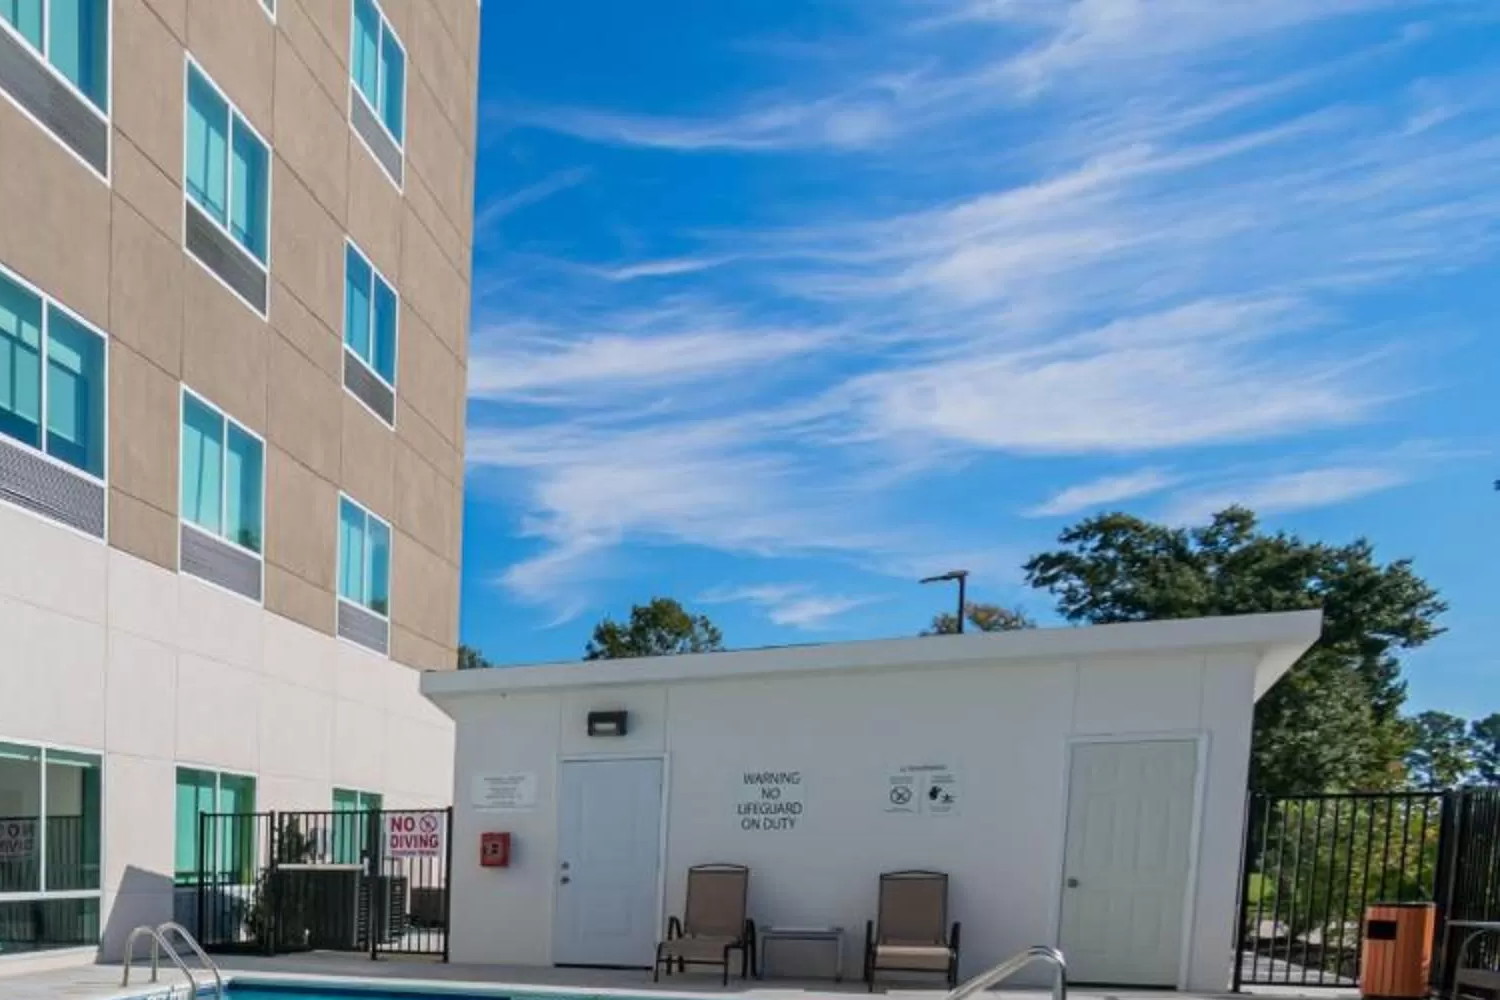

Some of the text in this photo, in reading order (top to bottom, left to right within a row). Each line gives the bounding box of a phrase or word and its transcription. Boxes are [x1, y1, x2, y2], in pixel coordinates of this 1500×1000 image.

[743, 771, 801, 785] WARNING
[761, 786, 781, 800] NO
[737, 801, 803, 815] LIFEGUARD
[390, 815, 415, 832] NO
[740, 817, 796, 830] ON DUTY
[389, 834, 439, 849] DIVING
